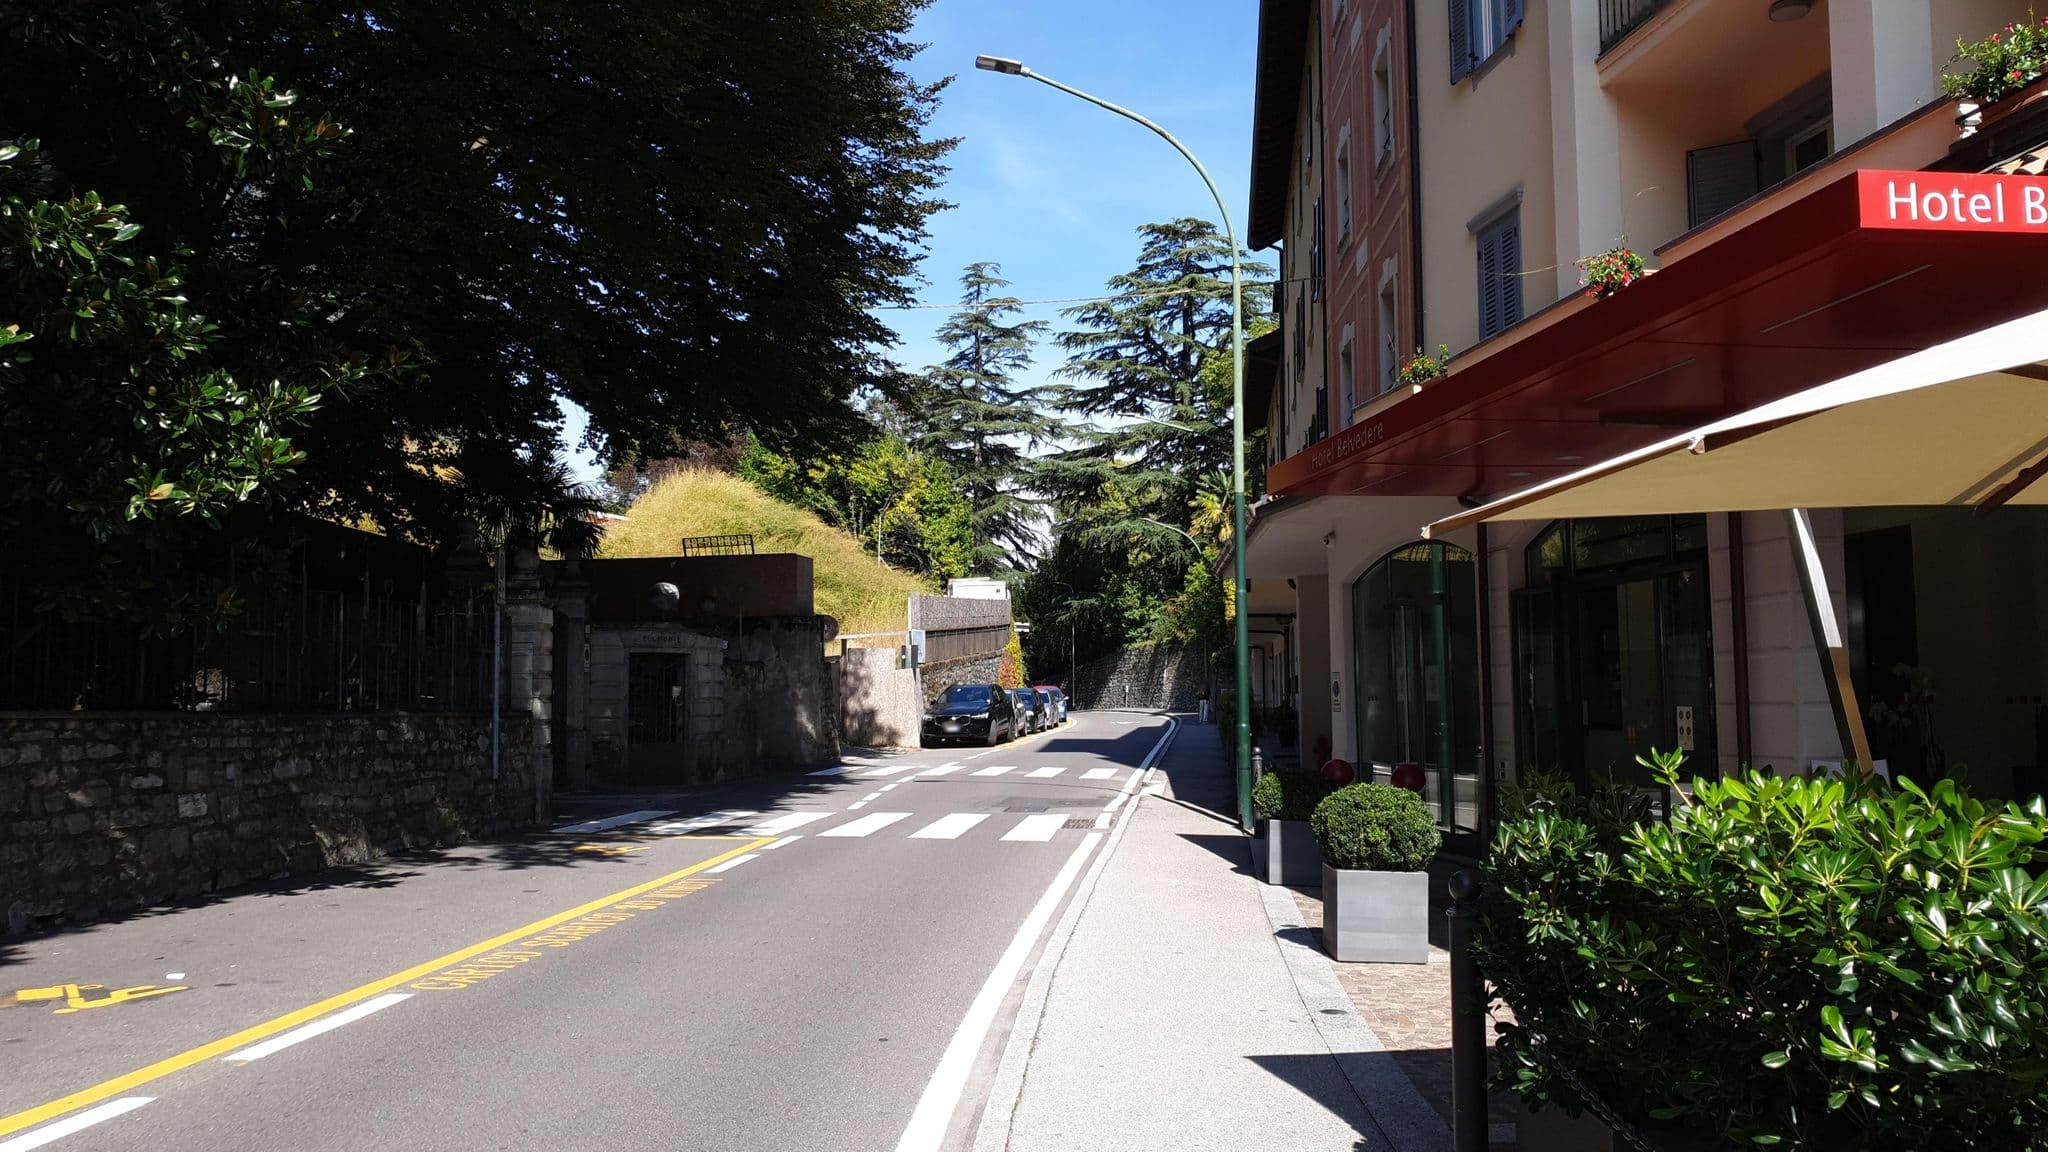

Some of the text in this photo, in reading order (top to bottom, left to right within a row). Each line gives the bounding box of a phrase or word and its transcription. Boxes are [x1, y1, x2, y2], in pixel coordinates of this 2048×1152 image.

[1888, 181, 2005, 223] Hotel
[1311, 423, 1384, 469] Hotel Belvedere
[410, 951, 542, 990] CARICO
[521, 911, 636, 948] SCARICO
